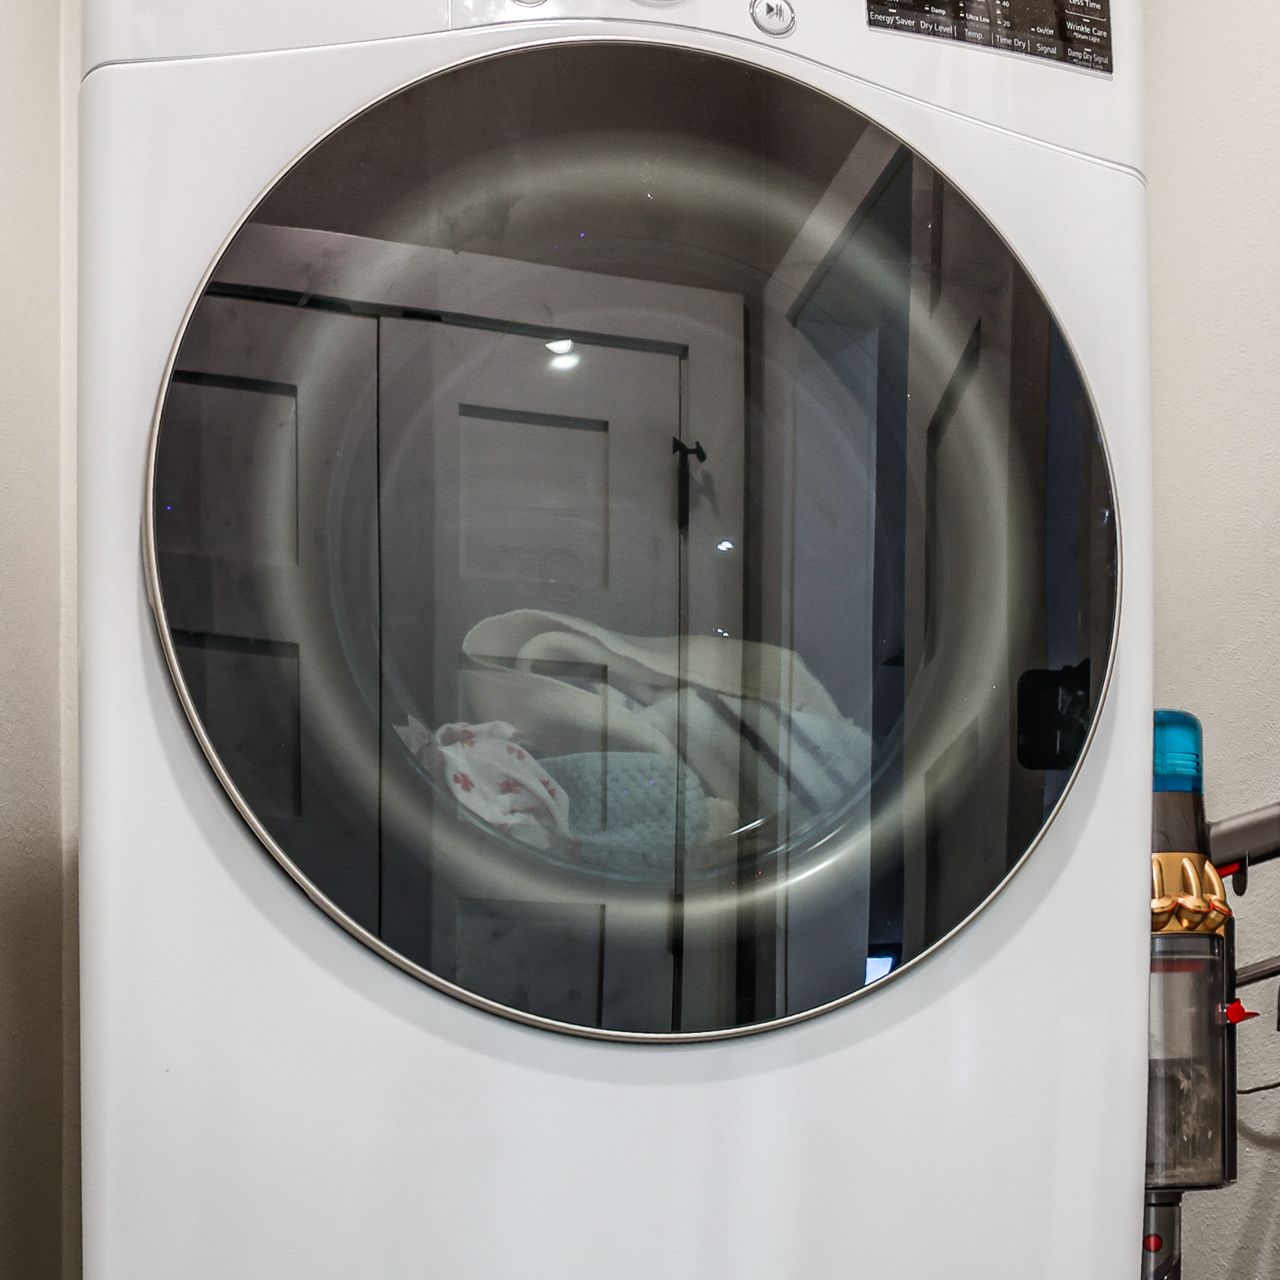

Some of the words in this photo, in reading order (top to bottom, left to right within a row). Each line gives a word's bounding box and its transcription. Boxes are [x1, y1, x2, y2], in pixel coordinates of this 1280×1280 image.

[870, 11, 894, 24] Energy
[896, 17, 915, 26] Saver
[920, 21, 933, 32] Dry
[935, 23, 953, 34] Level
[1066, 22, 1091, 34] Wrinkle
[1092, 27, 1107, 37] Care
[996, 35, 1012, 45] Time
[1014, 39, 1026, 49] Dry
[1037, 43, 1057, 54] Signal
[1068, 48, 1082, 59] Damp
[1083, 52, 1092, 61] Dry
